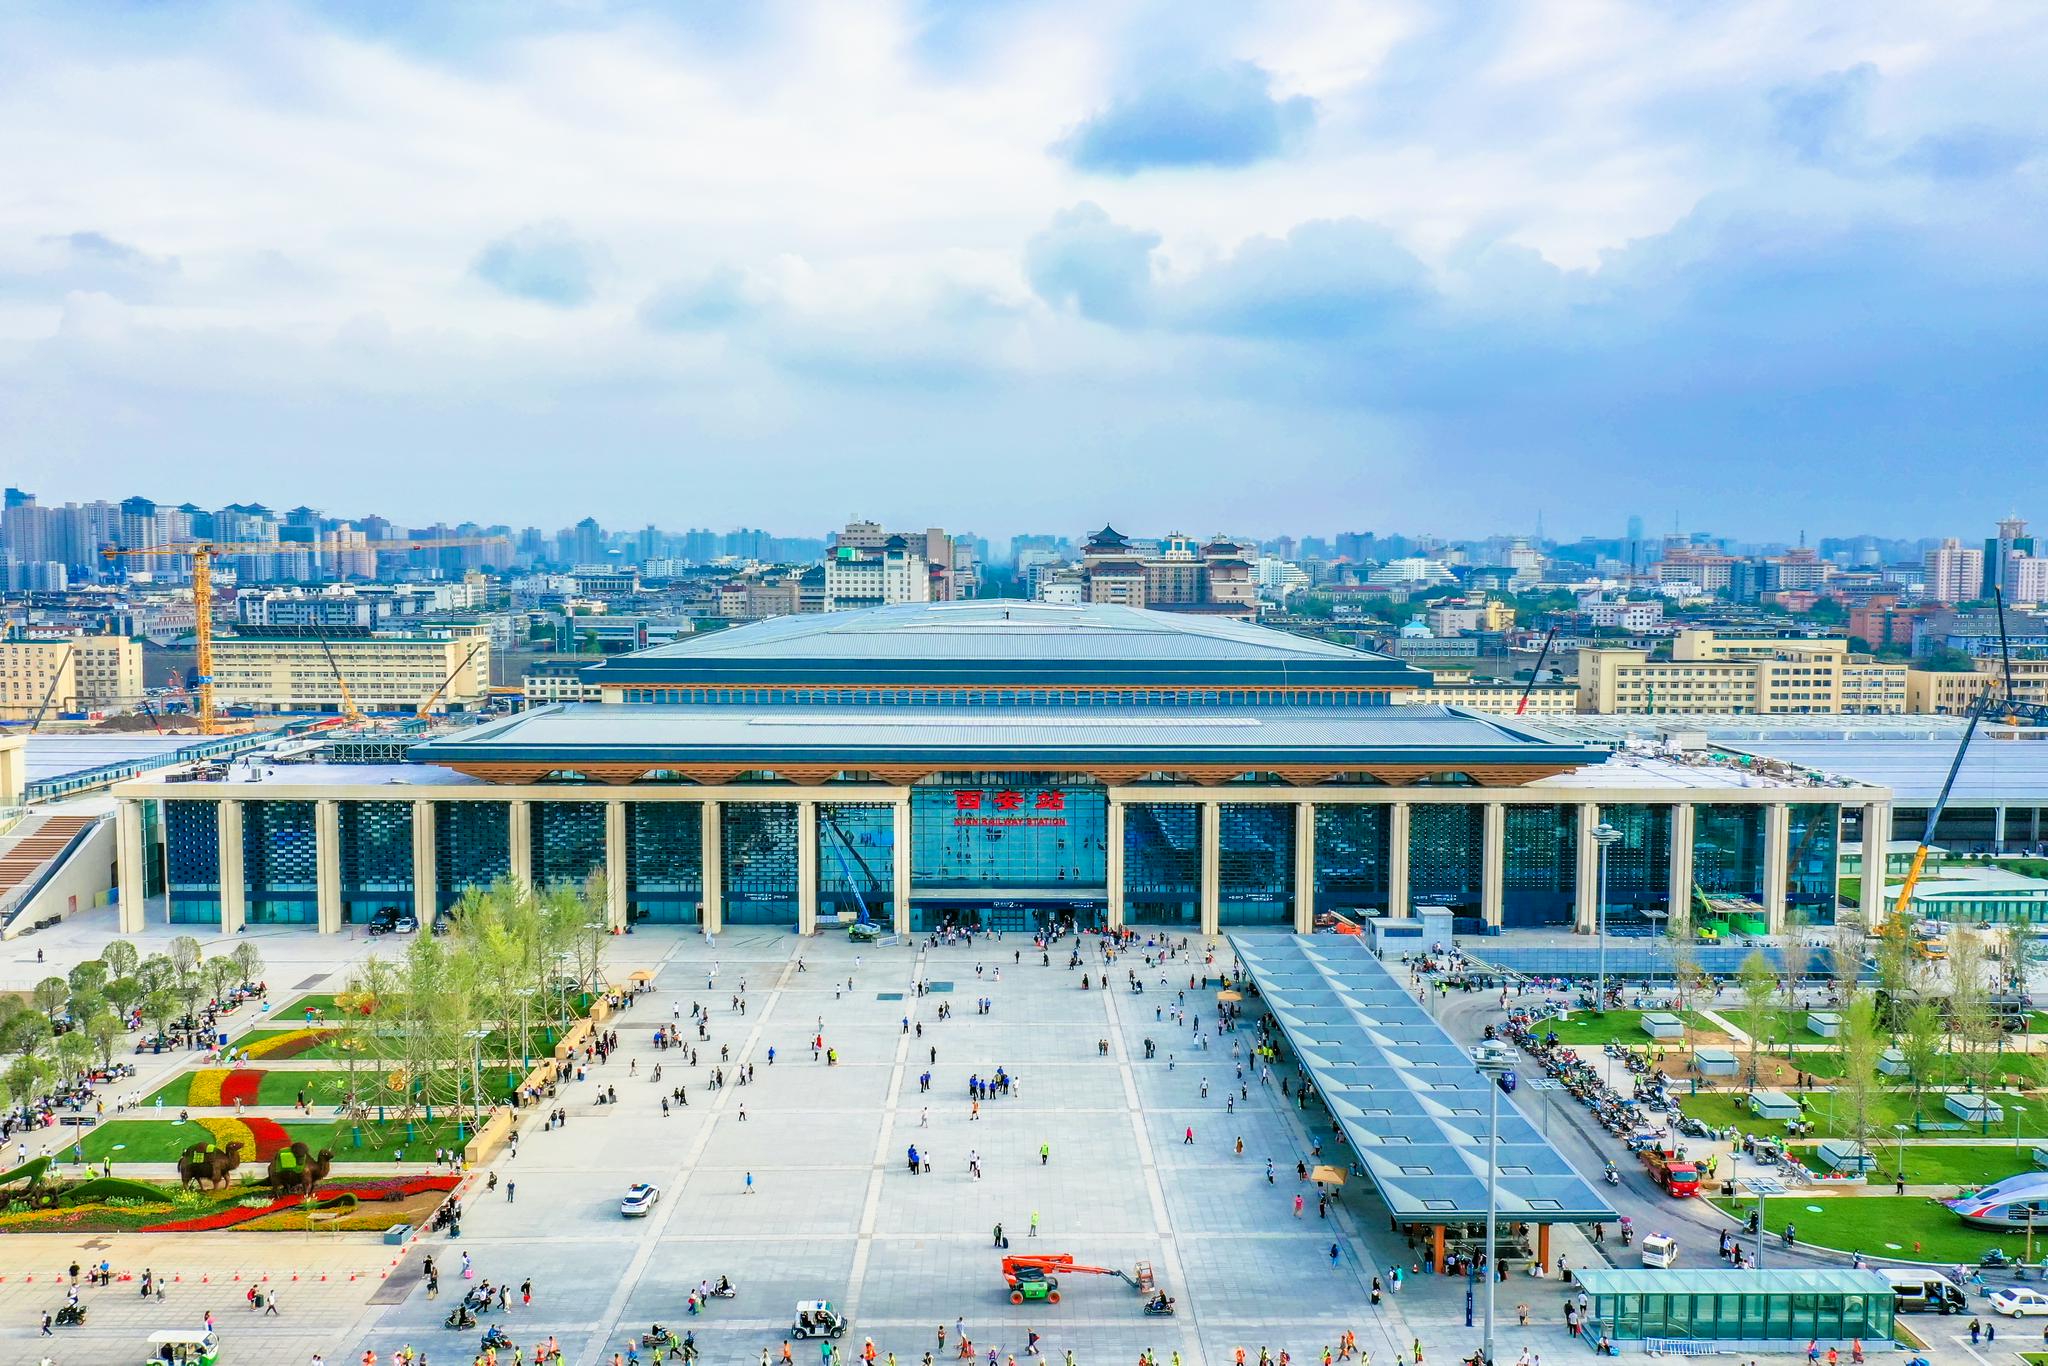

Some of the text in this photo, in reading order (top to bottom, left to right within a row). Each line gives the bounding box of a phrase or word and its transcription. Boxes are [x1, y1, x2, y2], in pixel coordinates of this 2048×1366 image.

[953, 789, 1066, 810] 西安站
[981, 817, 1023, 826] RAILWAY
[1026, 817, 1066, 826] STATION
